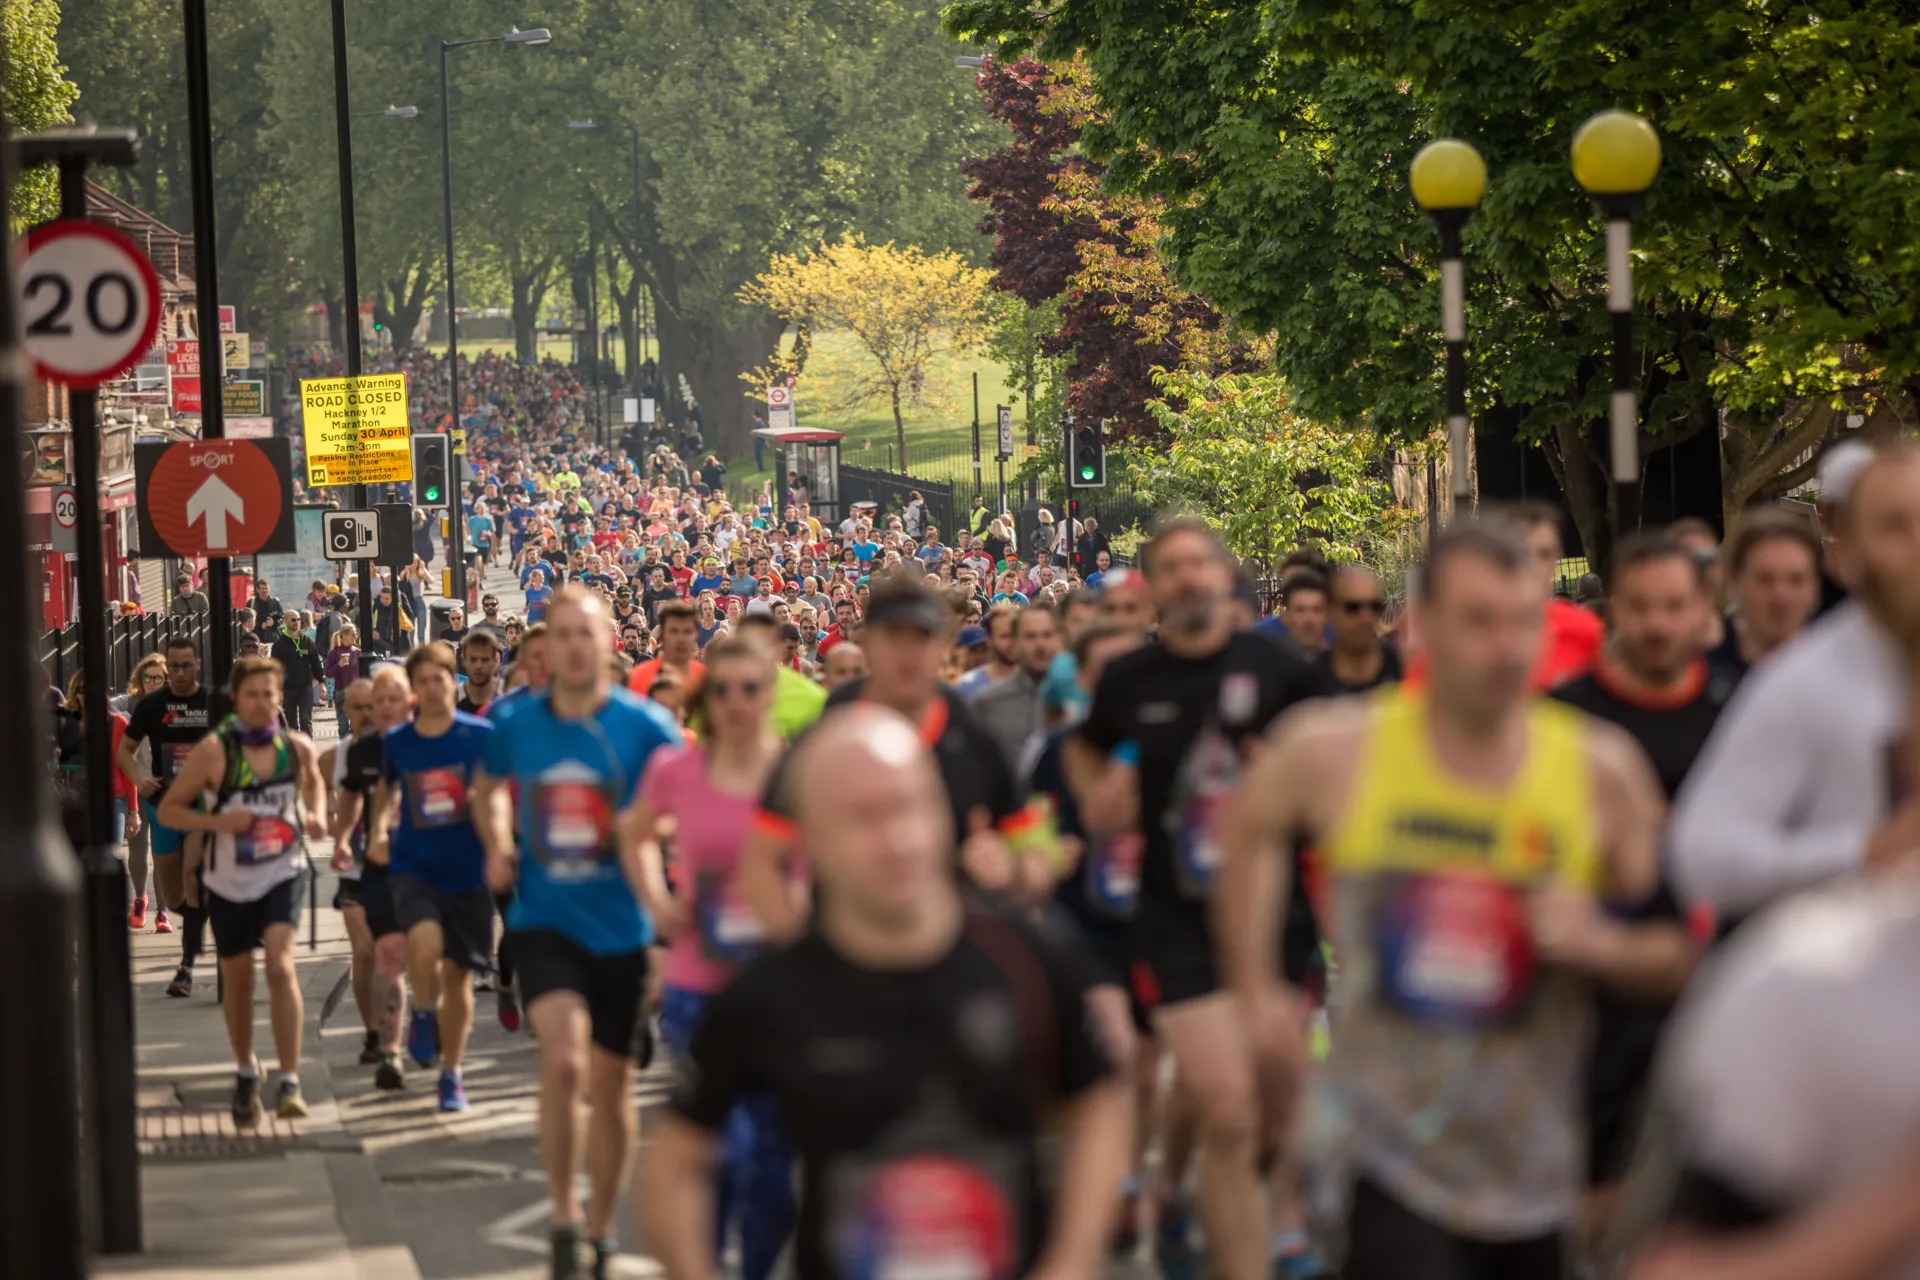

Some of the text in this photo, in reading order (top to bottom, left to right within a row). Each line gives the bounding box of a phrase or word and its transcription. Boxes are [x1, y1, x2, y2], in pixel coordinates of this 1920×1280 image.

[23, 272, 138, 337] 20
[306, 378, 401, 393] Advance Warning
[306, 392, 402, 408] ROAD CLOSED
[324, 406, 386, 418] Hackney 1/2
[332, 420, 380, 430] Marathon
[321, 427, 406, 442] Sunday 30 April
[334, 442, 381, 452] 7am-3pm
[190, 452, 234, 469] SPORT
[318, 451, 395, 462] Parking Restrictions
[58, 502, 76, 517] 20
